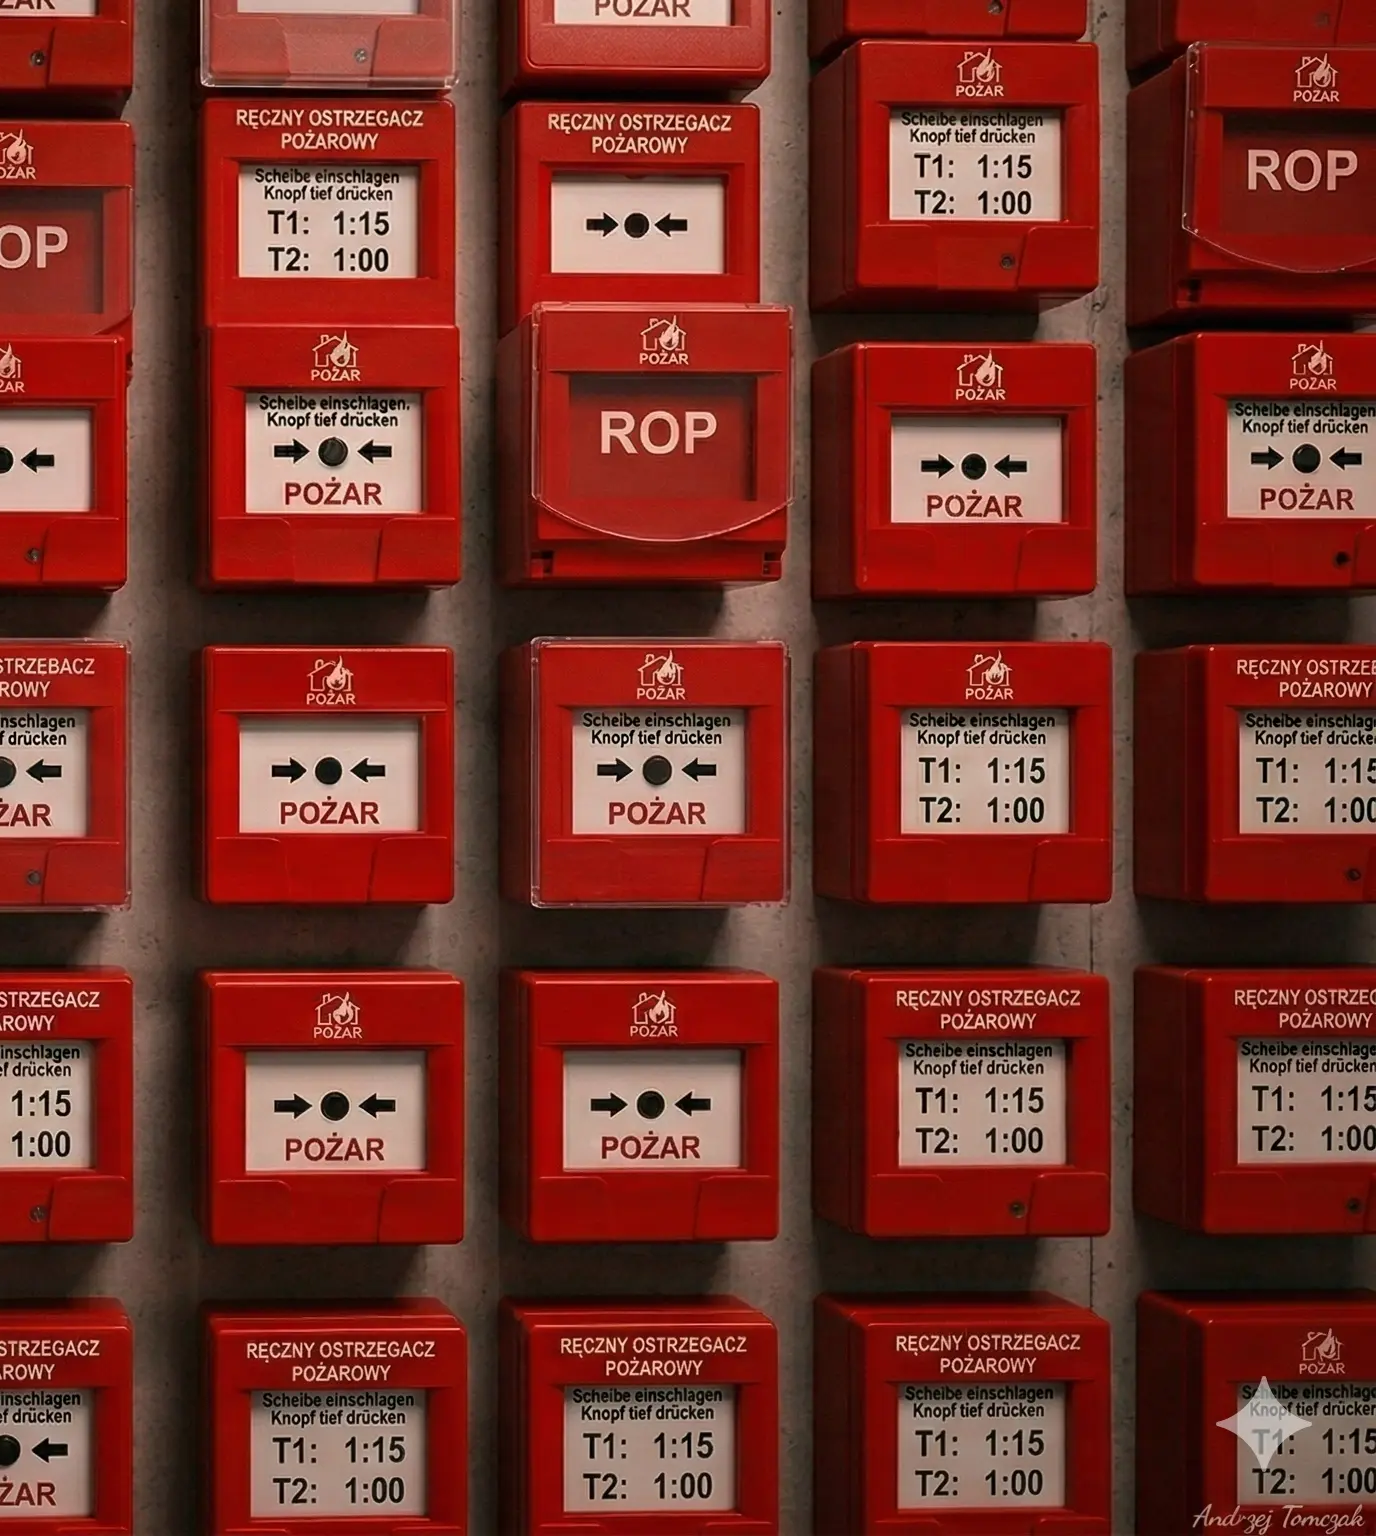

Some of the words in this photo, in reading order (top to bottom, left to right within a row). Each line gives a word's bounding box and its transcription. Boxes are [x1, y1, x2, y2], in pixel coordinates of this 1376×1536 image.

[236, 109, 304, 129] RĘCZNY
[309, 110, 424, 127] OSTRZEGACZ
[548, 114, 615, 134] RĘCZNY
[620, 114, 732, 132] OSTRZEGACZ
[281, 129, 378, 150] POŻAROWY
[592, 133, 688, 154] POŻAROWY
[255, 168, 311, 184] Scheibe
[315, 169, 400, 188] einschlagen
[914, 153, 954, 178] T1:
[978, 154, 1032, 179] 1:15
[1248, 149, 1358, 192] ROP
[264, 185, 308, 204] Knopf
[310, 186, 333, 200] tief
[336, 186, 392, 201] drücken
[914, 190, 954, 214] T2:
[978, 191, 1032, 215] 1:00
[267, 210, 309, 234] T1:
[334, 211, 390, 236] 1:15
[268, 247, 309, 272] T2:
[334, 247, 389, 272] 1:00
[601, 411, 717, 454] ROP
[285, 477, 382, 506] POŻAR
[927, 489, 1023, 518] POŻAR
[1260, 483, 1354, 510] POŻAR
[909, 712, 966, 728] Scheibe
[970, 712, 1056, 732] einschlagen
[918, 729, 960, 748] Knopf
[963, 730, 986, 744] tief
[989, 730, 1046, 745] drücken
[918, 757, 960, 784] T1:
[988, 757, 1045, 784] 1:15
[280, 796, 380, 825] POŻAR
[609, 796, 706, 825] POŻAR
[919, 797, 960, 823] T2:
[987, 797, 1044, 824] 1:00
[896, 990, 964, 1011] RĘCZNY
[967, 989, 1080, 1008] OSTRZEGACZ
[12, 1061, 71, 1077] drücken
[12, 1090, 71, 1117] 1:15
[915, 1087, 958, 1114] T1:
[985, 1087, 1044, 1114] 1:15
[12, 1131, 70, 1158] 1:00
[286, 1132, 384, 1162] POŻAR
[602, 1131, 700, 1160] POŻAR
[915, 1128, 958, 1154] T2:
[986, 1127, 1043, 1154] 1:00
[247, 1342, 315, 1363] RĘCZNY
[320, 1341, 435, 1358] OSTRZEGACZ
[561, 1337, 628, 1358] RĘCZNY
[632, 1336, 747, 1354] OSTRZEGACZ
[896, 1335, 963, 1356] RĘCZNY
[292, 1362, 391, 1382] POŻAROWY
[606, 1356, 703, 1376] POŻAROWY
[940, 1354, 1036, 1374] POŻAROWY
[12, 1407, 72, 1424] drücken
[272, 1437, 316, 1464] T1:
[345, 1436, 406, 1463] 1:15
[582, 1432, 626, 1459] T1:
[654, 1432, 714, 1459] 1:15
[915, 1430, 958, 1457] T1:
[986, 1429, 1044, 1456] 1:15
[272, 1478, 316, 1504] T2:
[345, 1477, 404, 1504] 1:00
[582, 1473, 626, 1500] T2:
[654, 1472, 712, 1499] 1:00
[914, 1470, 958, 1496] T2:
[985, 1469, 1043, 1496] 1:00
